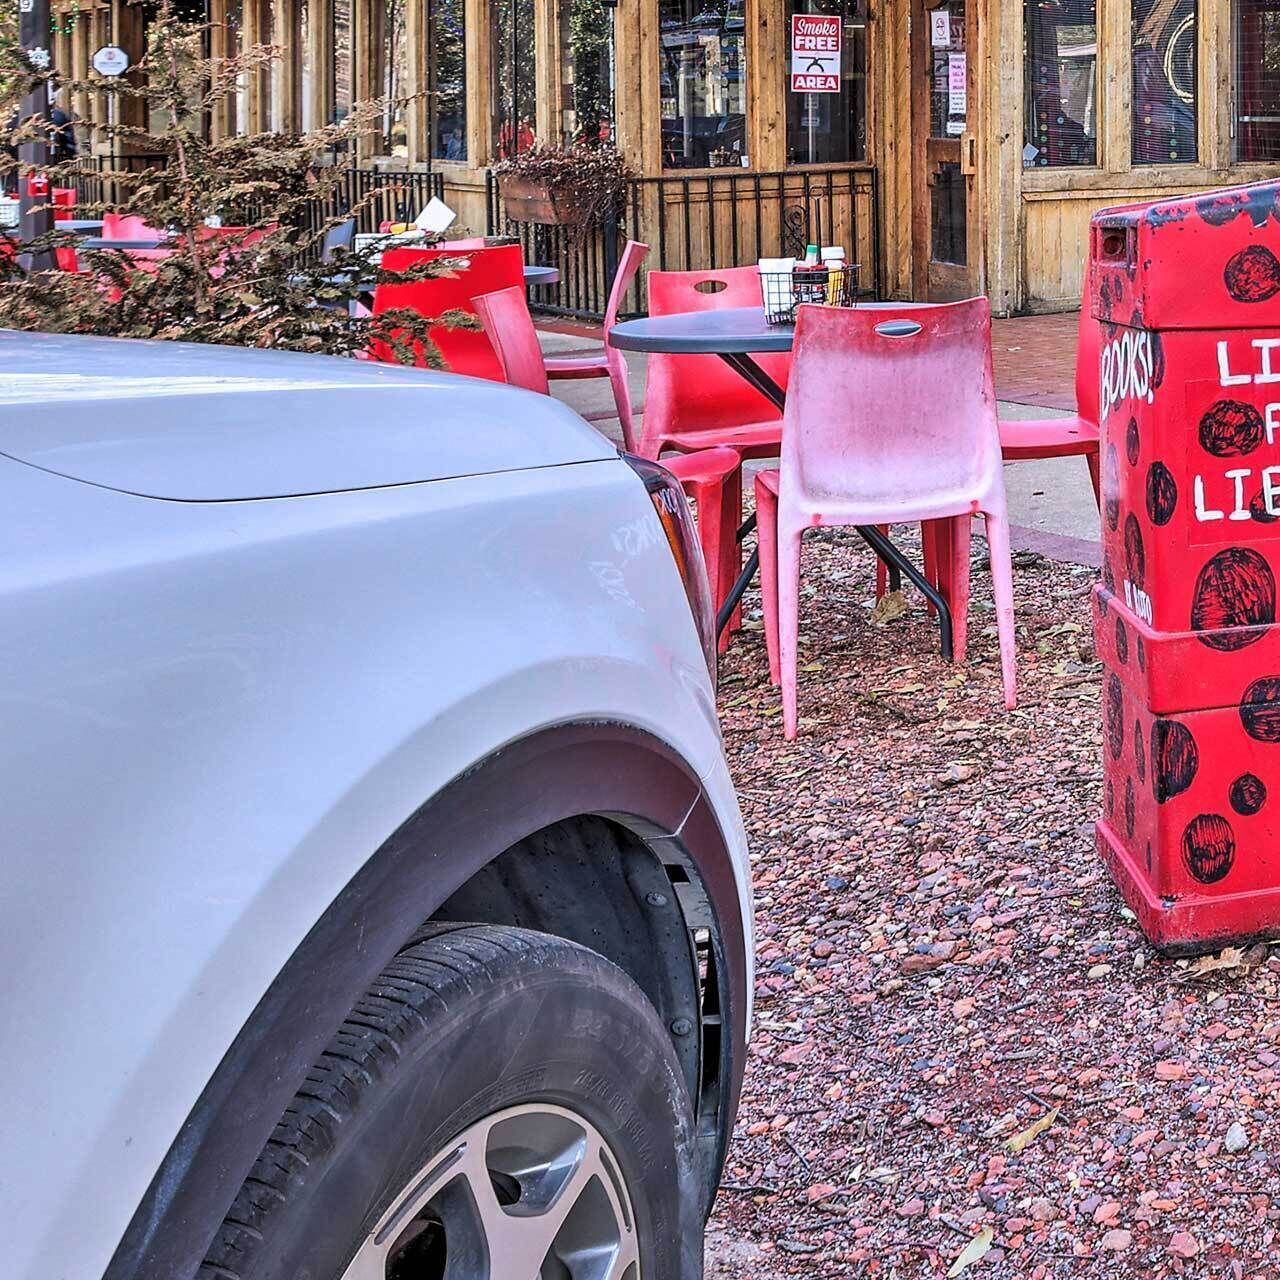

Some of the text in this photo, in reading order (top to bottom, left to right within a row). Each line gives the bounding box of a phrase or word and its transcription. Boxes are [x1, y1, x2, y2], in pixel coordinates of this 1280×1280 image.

[795, 18, 838, 36] Smoke
[794, 35, 838, 50] FREE
[794, 76, 838, 89] AREA
[1100, 330, 1154, 420] BOOKS!
